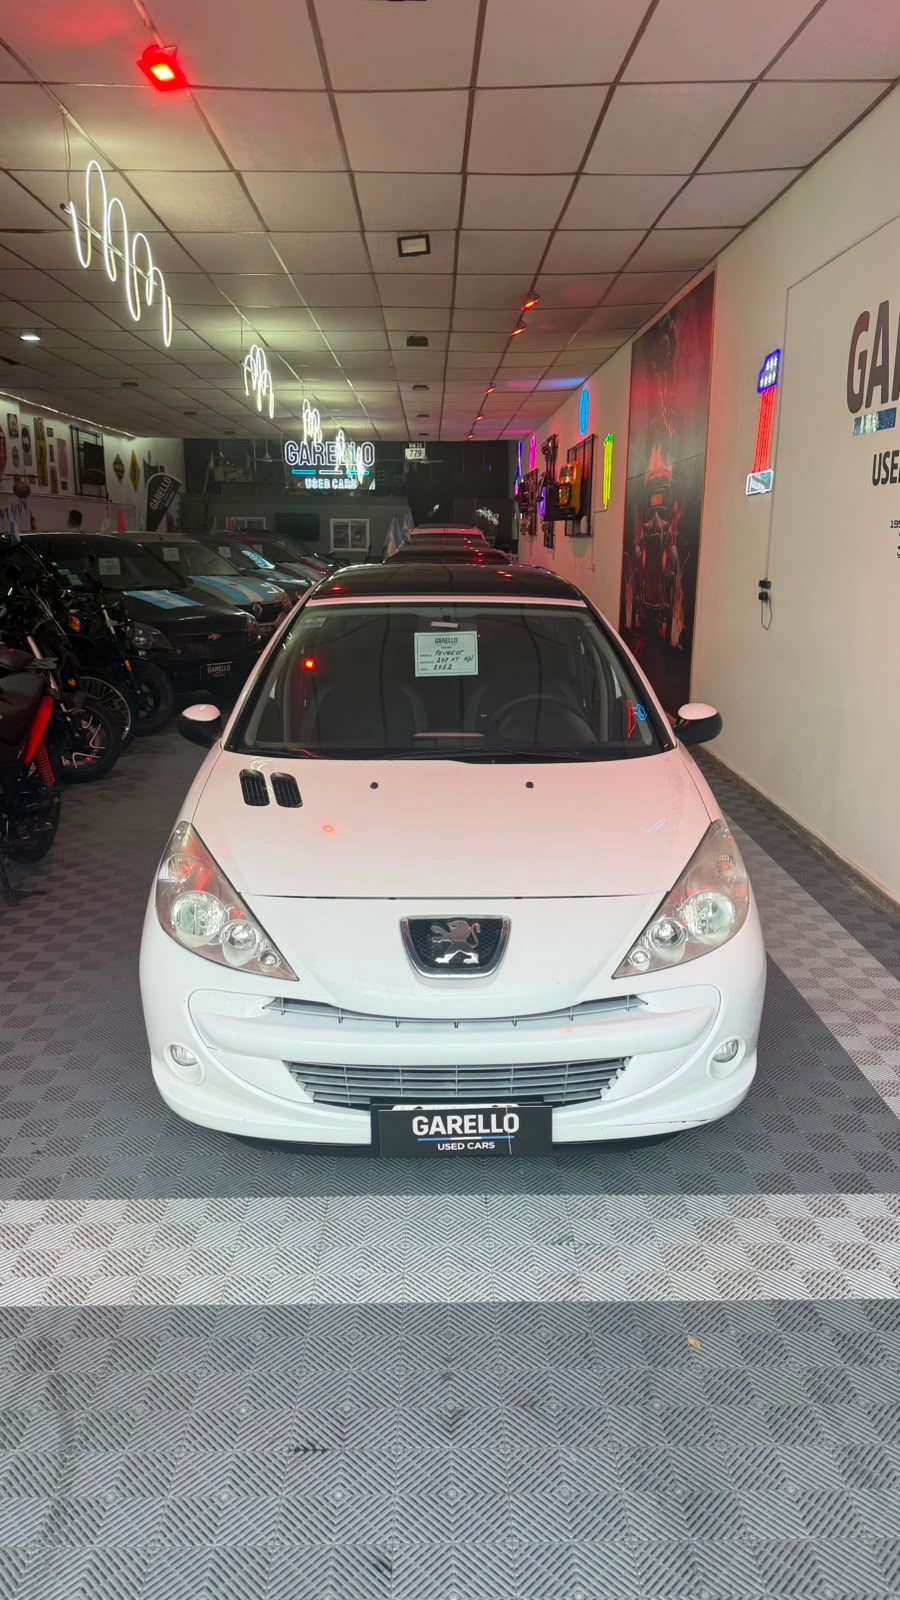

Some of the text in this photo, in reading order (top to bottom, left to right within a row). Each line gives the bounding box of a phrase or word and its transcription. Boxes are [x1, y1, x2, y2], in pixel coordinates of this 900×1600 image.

[846, 299, 900, 414] GA
[284, 441, 375, 467] GARELLO
[409, 449, 422, 458] 779
[872, 449, 900, 487] USE
[149, 476, 172, 510] GARELLO
[304, 478, 330, 490] USED
[412, 1113, 520, 1136] GARELLO
[437, 1141, 496, 1151] USED CARS
